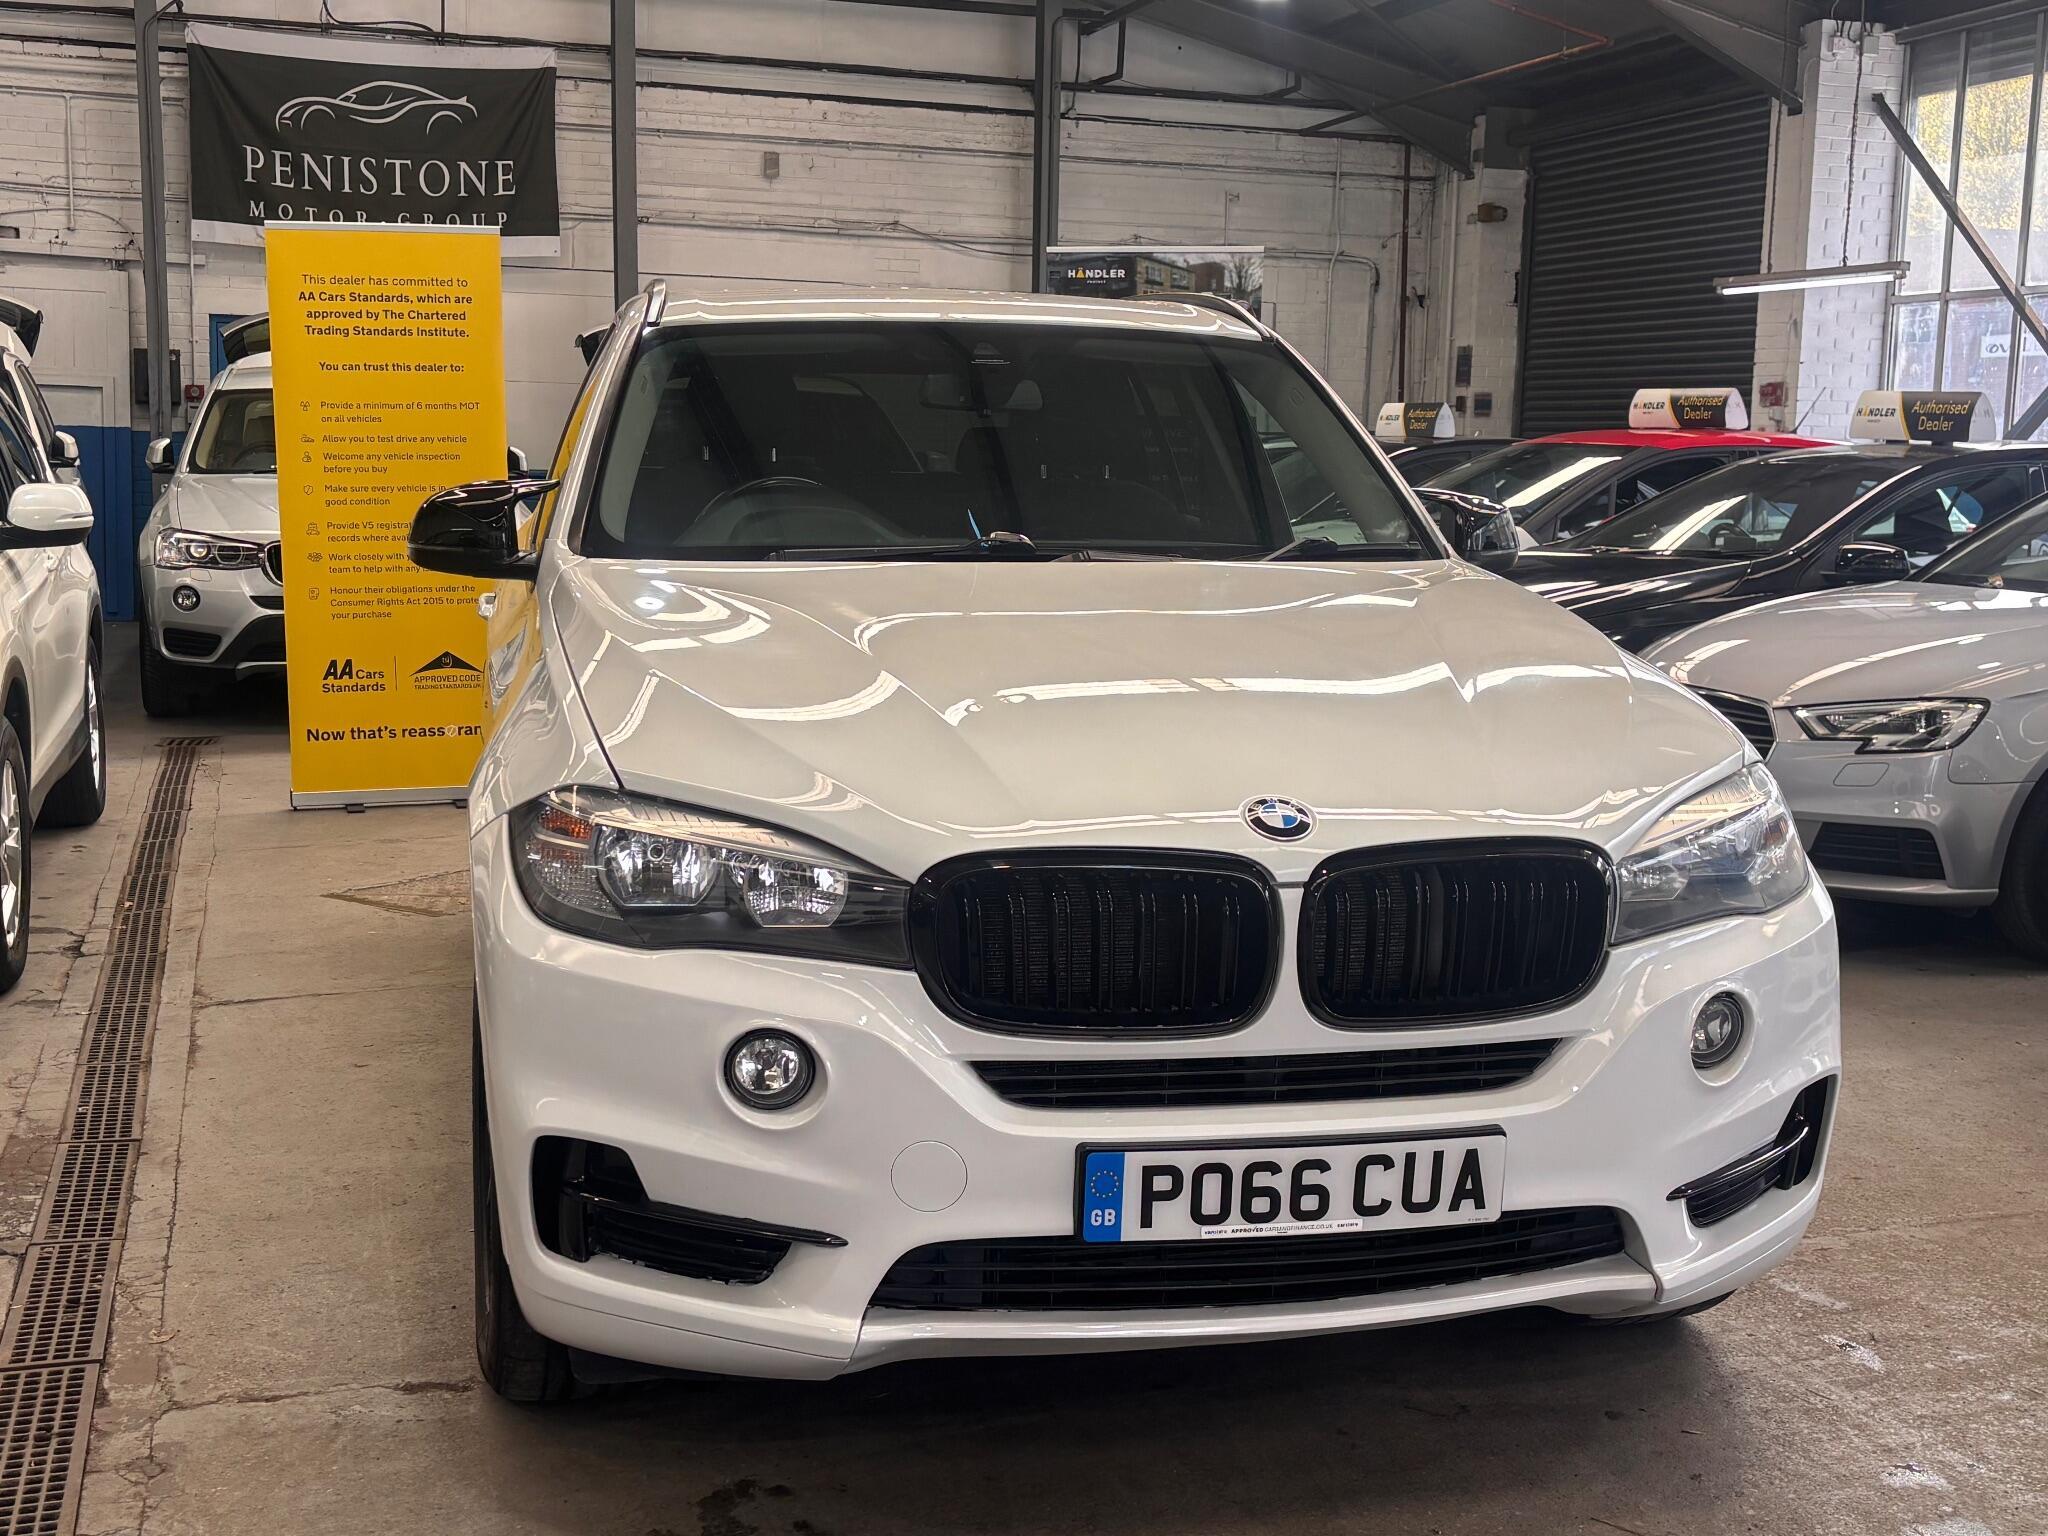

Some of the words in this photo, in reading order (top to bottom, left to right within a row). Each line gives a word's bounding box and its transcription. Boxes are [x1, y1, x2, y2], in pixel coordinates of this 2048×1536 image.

[242, 145, 516, 197] PENISTONE
[249, 200, 367, 223] MOTOR
[1067, 267, 1126, 279] HÄNDLER
[302, 274, 326, 285] This
[330, 275, 365, 286] dealer
[368, 275, 388, 286] has
[392, 276, 454, 287] committed
[456, 278, 468, 288] to
[298, 292, 316, 302] AA
[318, 292, 346, 302] Cars
[349, 292, 414, 305] Standards,
[416, 294, 452, 304] which
[454, 296, 473, 304] are
[306, 310, 363, 322] approved
[366, 310, 380, 322] by
[382, 310, 405, 320] The
[407, 310, 467, 321] Chartered
[304, 326, 350, 338] Trading
[352, 326, 414, 337] Standards
[416, 326, 470, 338] Institute.
[319, 362, 339, 371] You
[341, 363, 361, 371] can
[363, 363, 389, 372] trust
[392, 362, 412, 372] this
[414, 362, 448, 372] dealer
[450, 363, 464, 373] to:
[320, 401, 354, 410] Provide
[363, 402, 404, 410] minimum
[406, 401, 415, 410] of
[416, 401, 422, 410] 6
[424, 402, 458, 410] months
[459, 402, 480, 410] MOT
[1912, 400, 1972, 414] Authorised
[334, 415, 345, 423] all
[346, 415, 382, 423] vehicles
[1684, 408, 1713, 419] Dealer
[1918, 416, 1954, 431] Dealer
[322, 435, 347, 443] Allow
[348, 436, 364, 445] you
[366, 435, 375, 443] to
[377, 435, 394, 443] test
[396, 435, 418, 443] drive
[420, 436, 435, 445] any
[437, 435, 467, 443] vehicle
[323, 452, 364, 461] Welcome
[366, 454, 381, 462] any
[383, 452, 414, 461] vehicle
[416, 453, 461, 462] inspection
[323, 465, 351, 473] before
[353, 466, 369, 474] you
[371, 465, 388, 474] buy
[371, 486, 394, 494] every
[325, 498, 347, 507] good
[350, 497, 390, 506] condition
[327, 521, 360, 529] Provide
[362, 521, 374, 529] V5
[362, 534, 389, 542] where
[328, 553, 352, 561] Work
[354, 553, 384, 562] closely
[386, 553, 405, 561] with
[353, 565, 361, 573] to
[363, 565, 383, 575] help
[385, 565, 403, 573] with
[405, 566, 420, 575] any
[330, 586, 363, 594] Honour
[364, 586, 384, 594] their
[385, 585, 433, 595] obligations
[435, 585, 460, 593] under
[330, 599, 374, 607] Consumer
[376, 598, 404, 608] Rights
[406, 597, 421, 605] Act
[423, 597, 444, 605] 2015
[446, 597, 455, 605] to
[457, 597, 479, 606] prote
[331, 612, 350, 621] your
[352, 611, 392, 620] purchase
[322, 658, 354, 680] AA
[356, 669, 385, 680] Cars
[414, 674, 458, 683] APPROVED
[459, 674, 481, 682] CODE
[322, 682, 386, 694] Standards
[306, 728, 345, 742] Now
[350, 726, 397, 740] that's
[1139, 1158, 1332, 1229] PO66
[1352, 1148, 1487, 1218] CUA
[1090, 1208, 1116, 1226] GB
